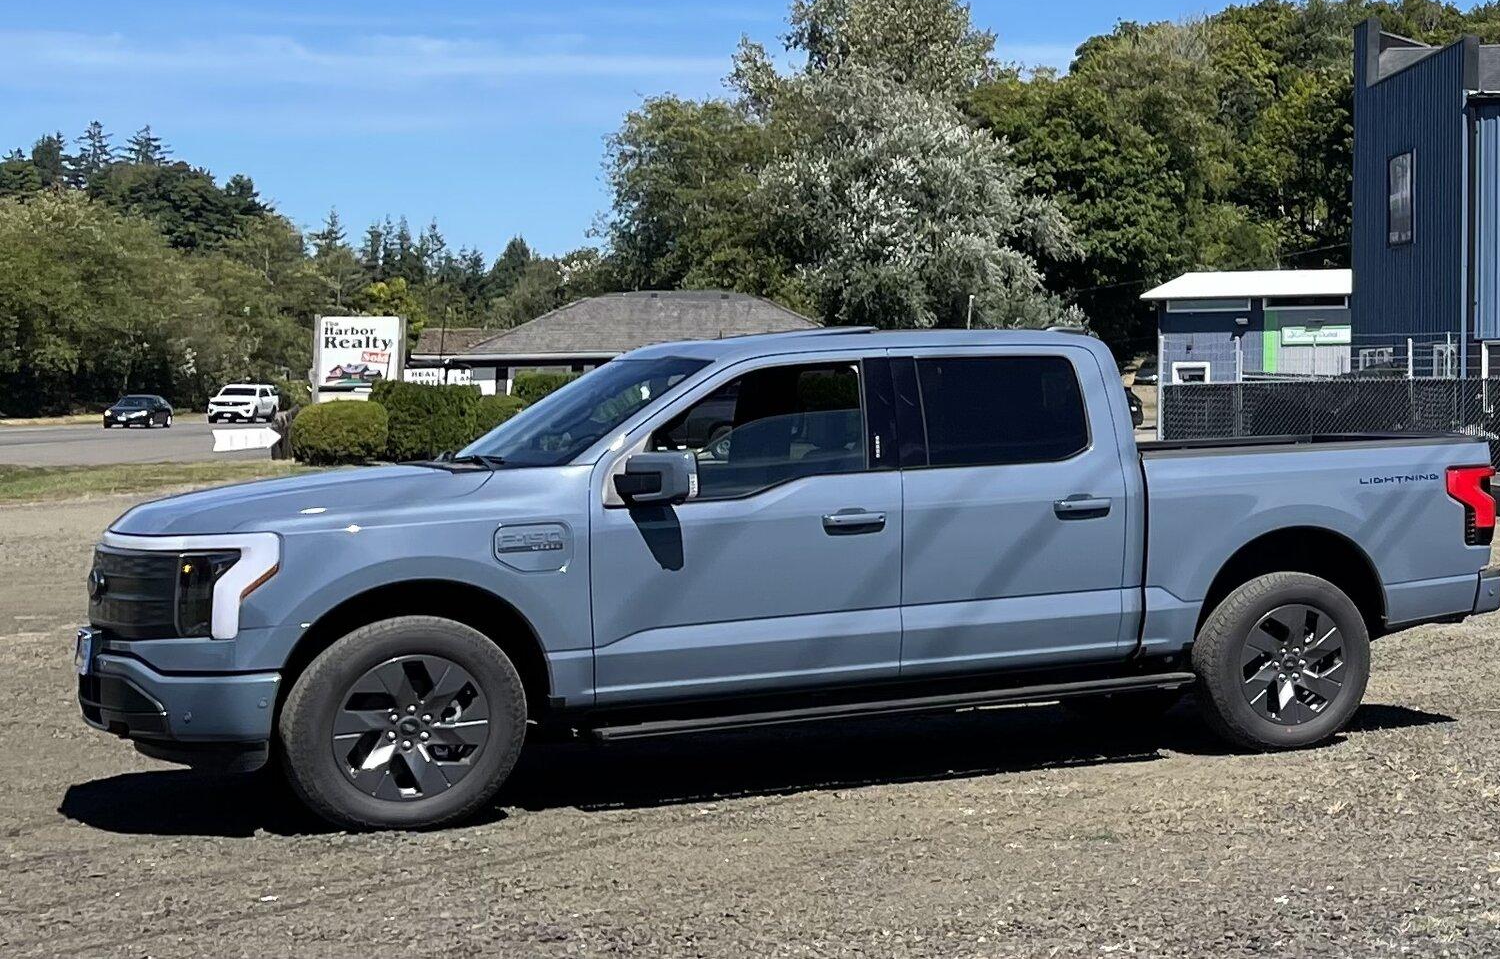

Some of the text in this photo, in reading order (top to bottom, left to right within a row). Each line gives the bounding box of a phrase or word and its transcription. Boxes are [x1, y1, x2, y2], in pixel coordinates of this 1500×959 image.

[324, 327, 376, 336] Harbor
[324, 336, 392, 351] Realty
[1359, 473, 1440, 485] LIGHTNING
